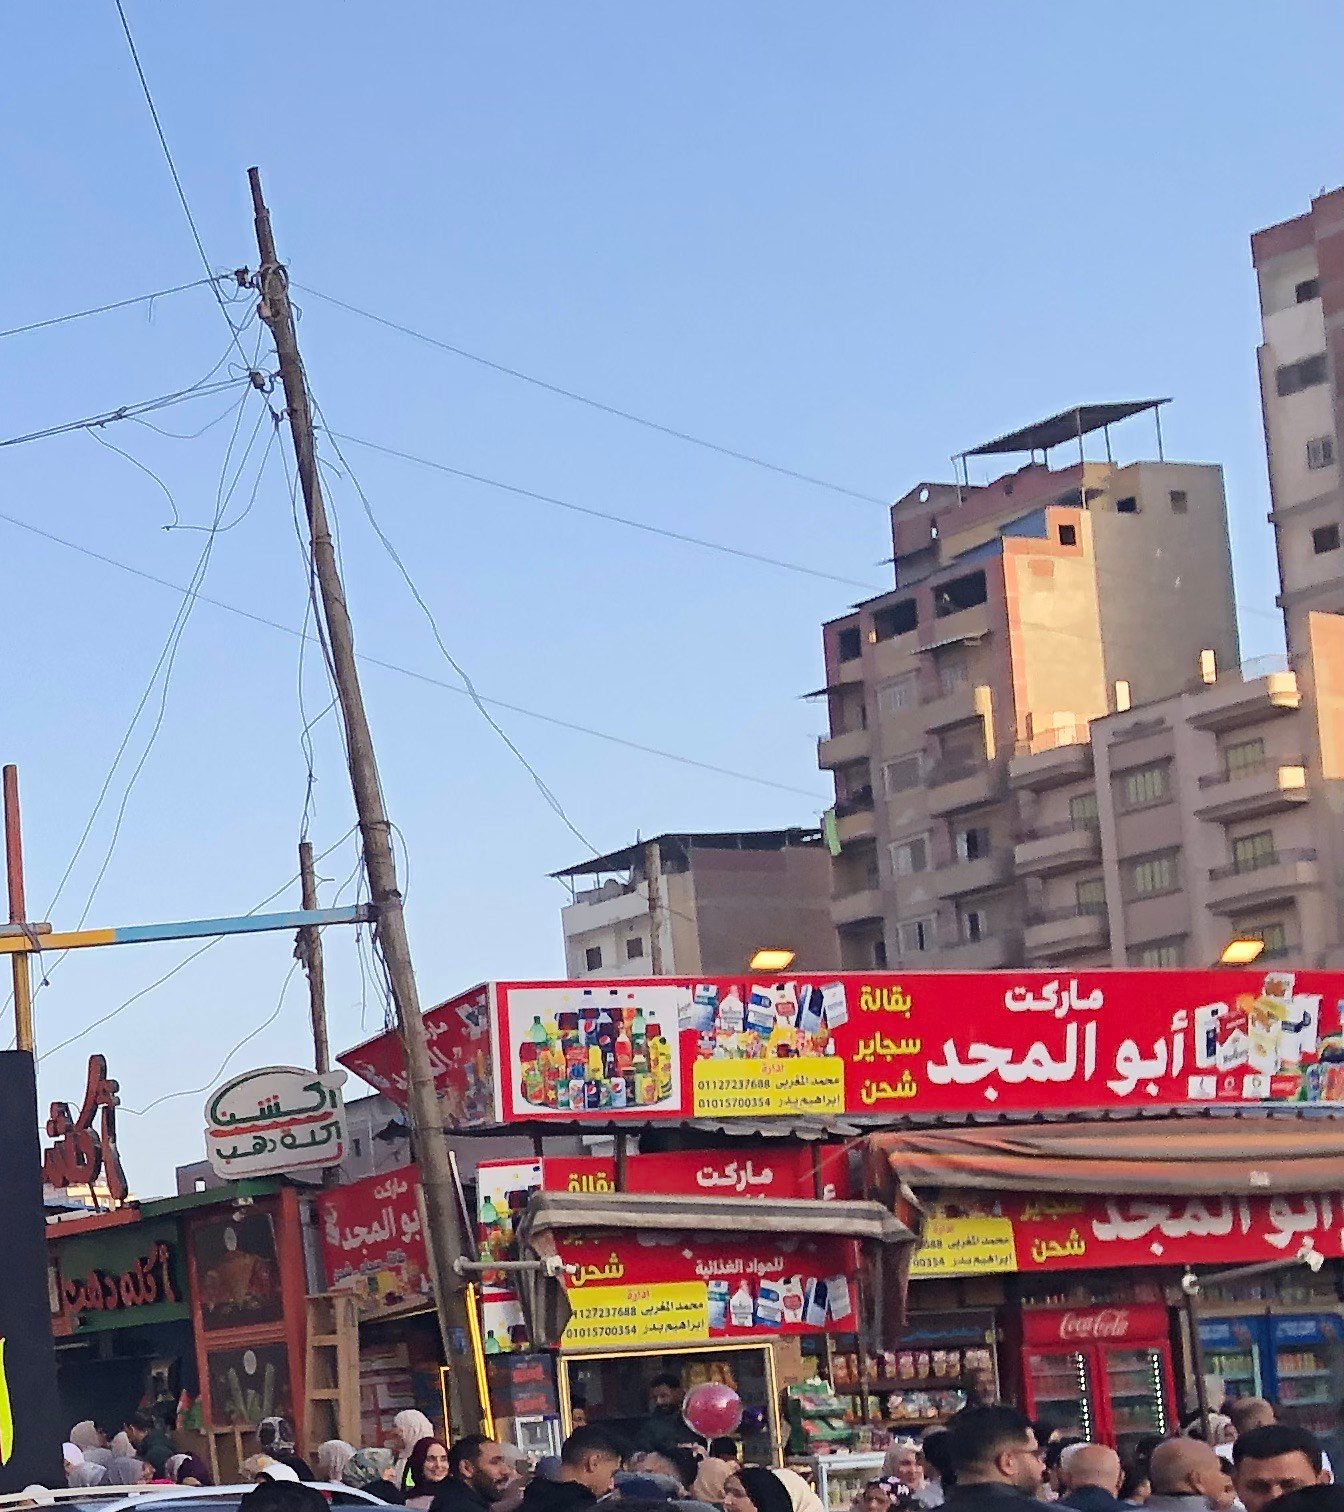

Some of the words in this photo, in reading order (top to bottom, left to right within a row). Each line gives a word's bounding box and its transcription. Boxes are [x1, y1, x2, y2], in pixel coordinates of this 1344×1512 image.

[860, 985, 912, 1018] بقالة
[1004, 979, 1104, 1019] ماركت
[853, 1031, 922, 1063] سجاير
[926, 1021, 1097, 1101] المجد
[1107, 1009, 1188, 1096] أبو
[698, 1097, 771, 1109] 01015700354
[861, 1069, 917, 1104] شحن
[696, 1160, 774, 1191] ماركت
[1031, 1227, 1086, 1264] شحن
